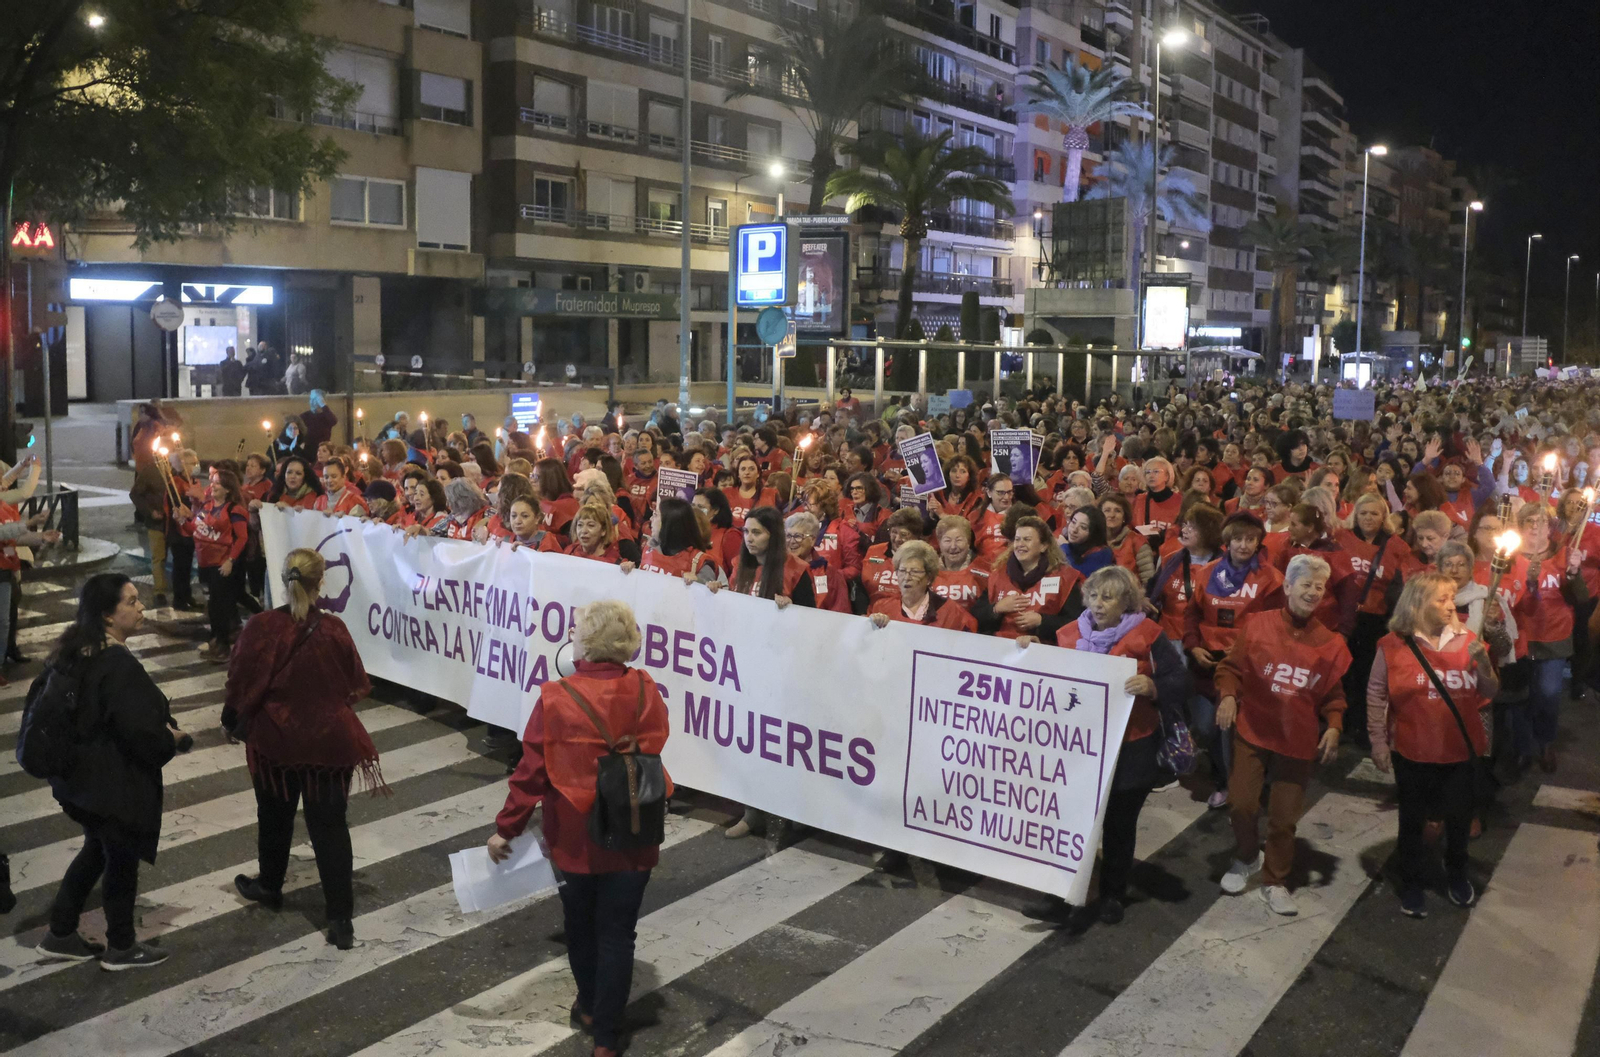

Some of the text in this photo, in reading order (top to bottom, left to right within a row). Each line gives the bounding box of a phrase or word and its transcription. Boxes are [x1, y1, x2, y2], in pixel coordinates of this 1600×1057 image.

[828, 216, 849, 224] GALLEGOS
[747, 232, 777, 273] P
[802, 243, 827, 253] BEEFEATER
[555, 292, 661, 315] Fraternidad Muprespa
[906, 457, 920, 467] 25N
[993, 448, 1009, 456] 25N
[631, 484, 650, 495] 25
[659, 488, 675, 498] 25N
[872, 569, 900, 586] #25
[368, 602, 440, 655] CONTRA
[442, 622, 466, 664] LA
[683, 690, 876, 786] MUJERES
[957, 670, 1058, 715] 25N DÍA
[918, 696, 1098, 757] INTERNACIONAL
[941, 735, 1067, 786] CONTRA LA
[941, 768, 1061, 821] VIOLENCIA
[912, 795, 1085, 862] A LAS MUJERES
